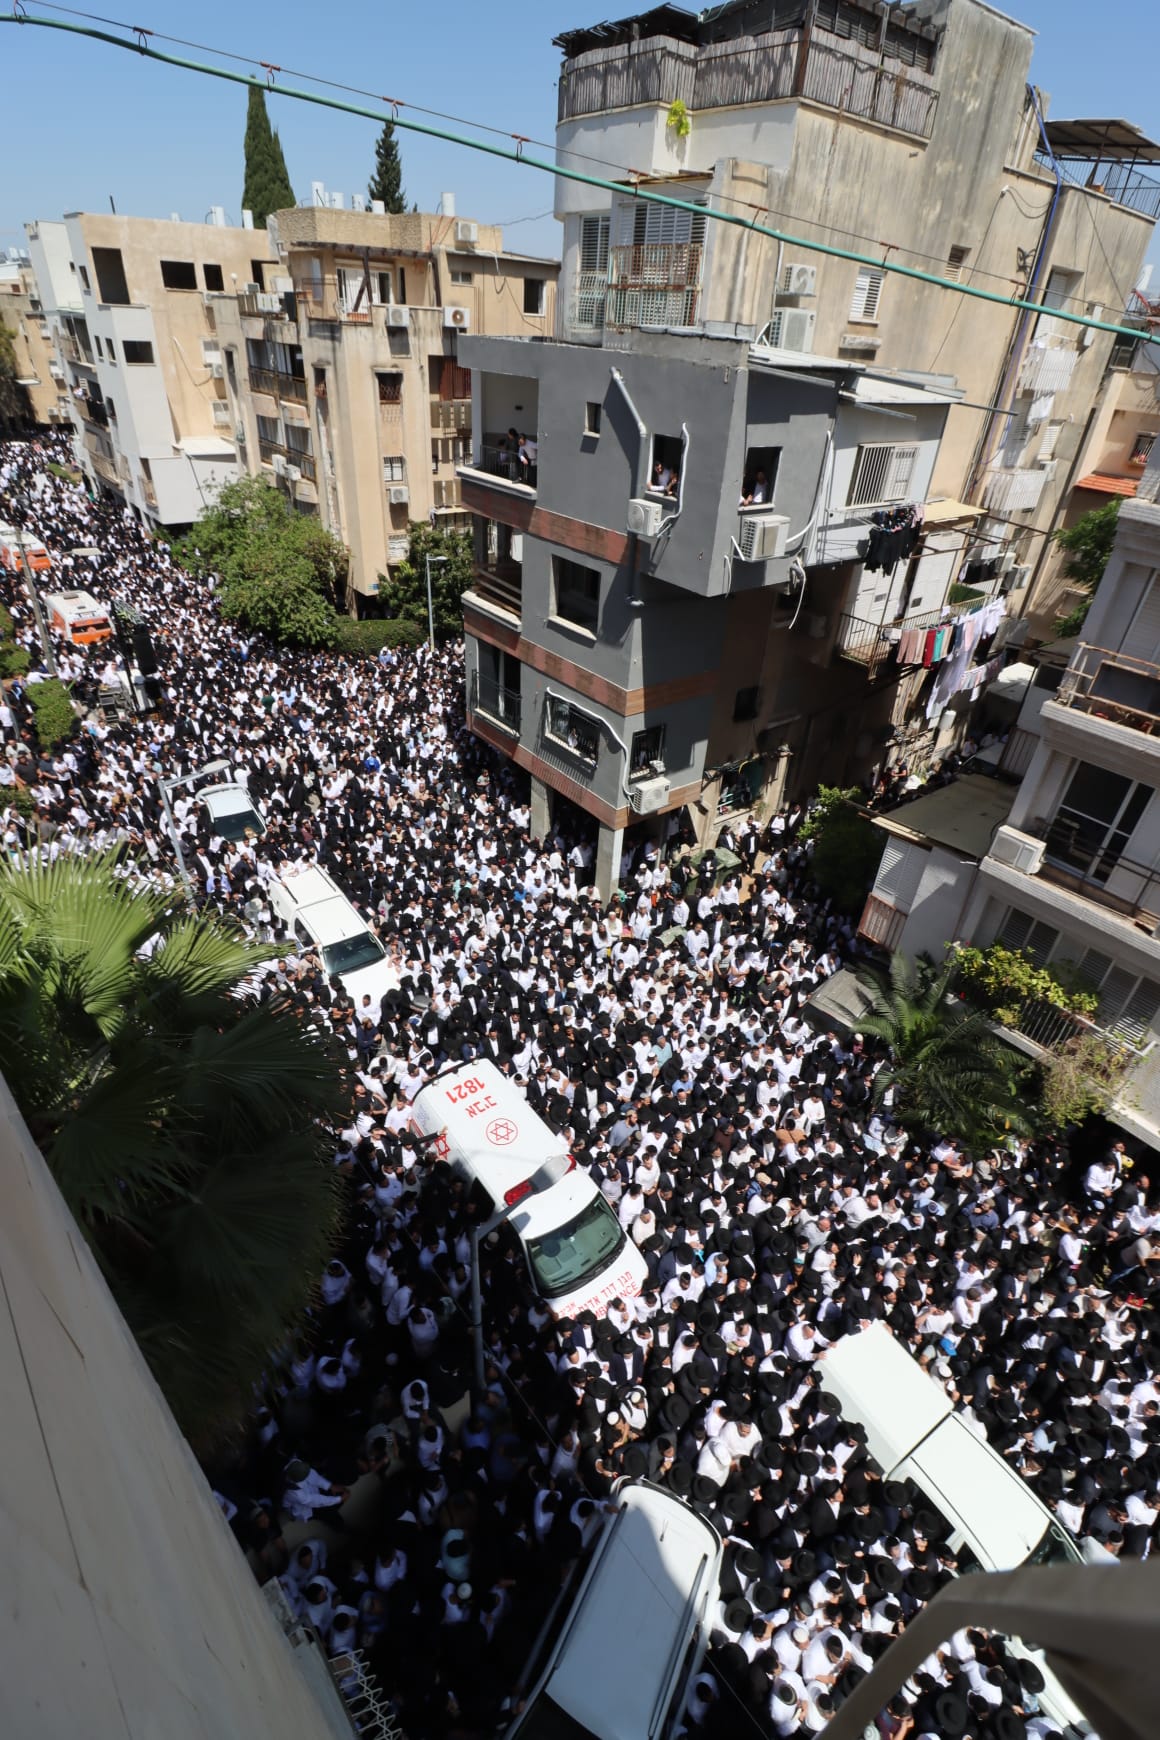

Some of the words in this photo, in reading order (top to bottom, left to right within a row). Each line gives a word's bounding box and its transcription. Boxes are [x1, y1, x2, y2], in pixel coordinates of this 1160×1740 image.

[446, 1077, 485, 1104] 1821
[465, 1095, 497, 1118] אביב
[617, 1271, 633, 1287] מגן
[600, 1282, 617, 1298] דוד
